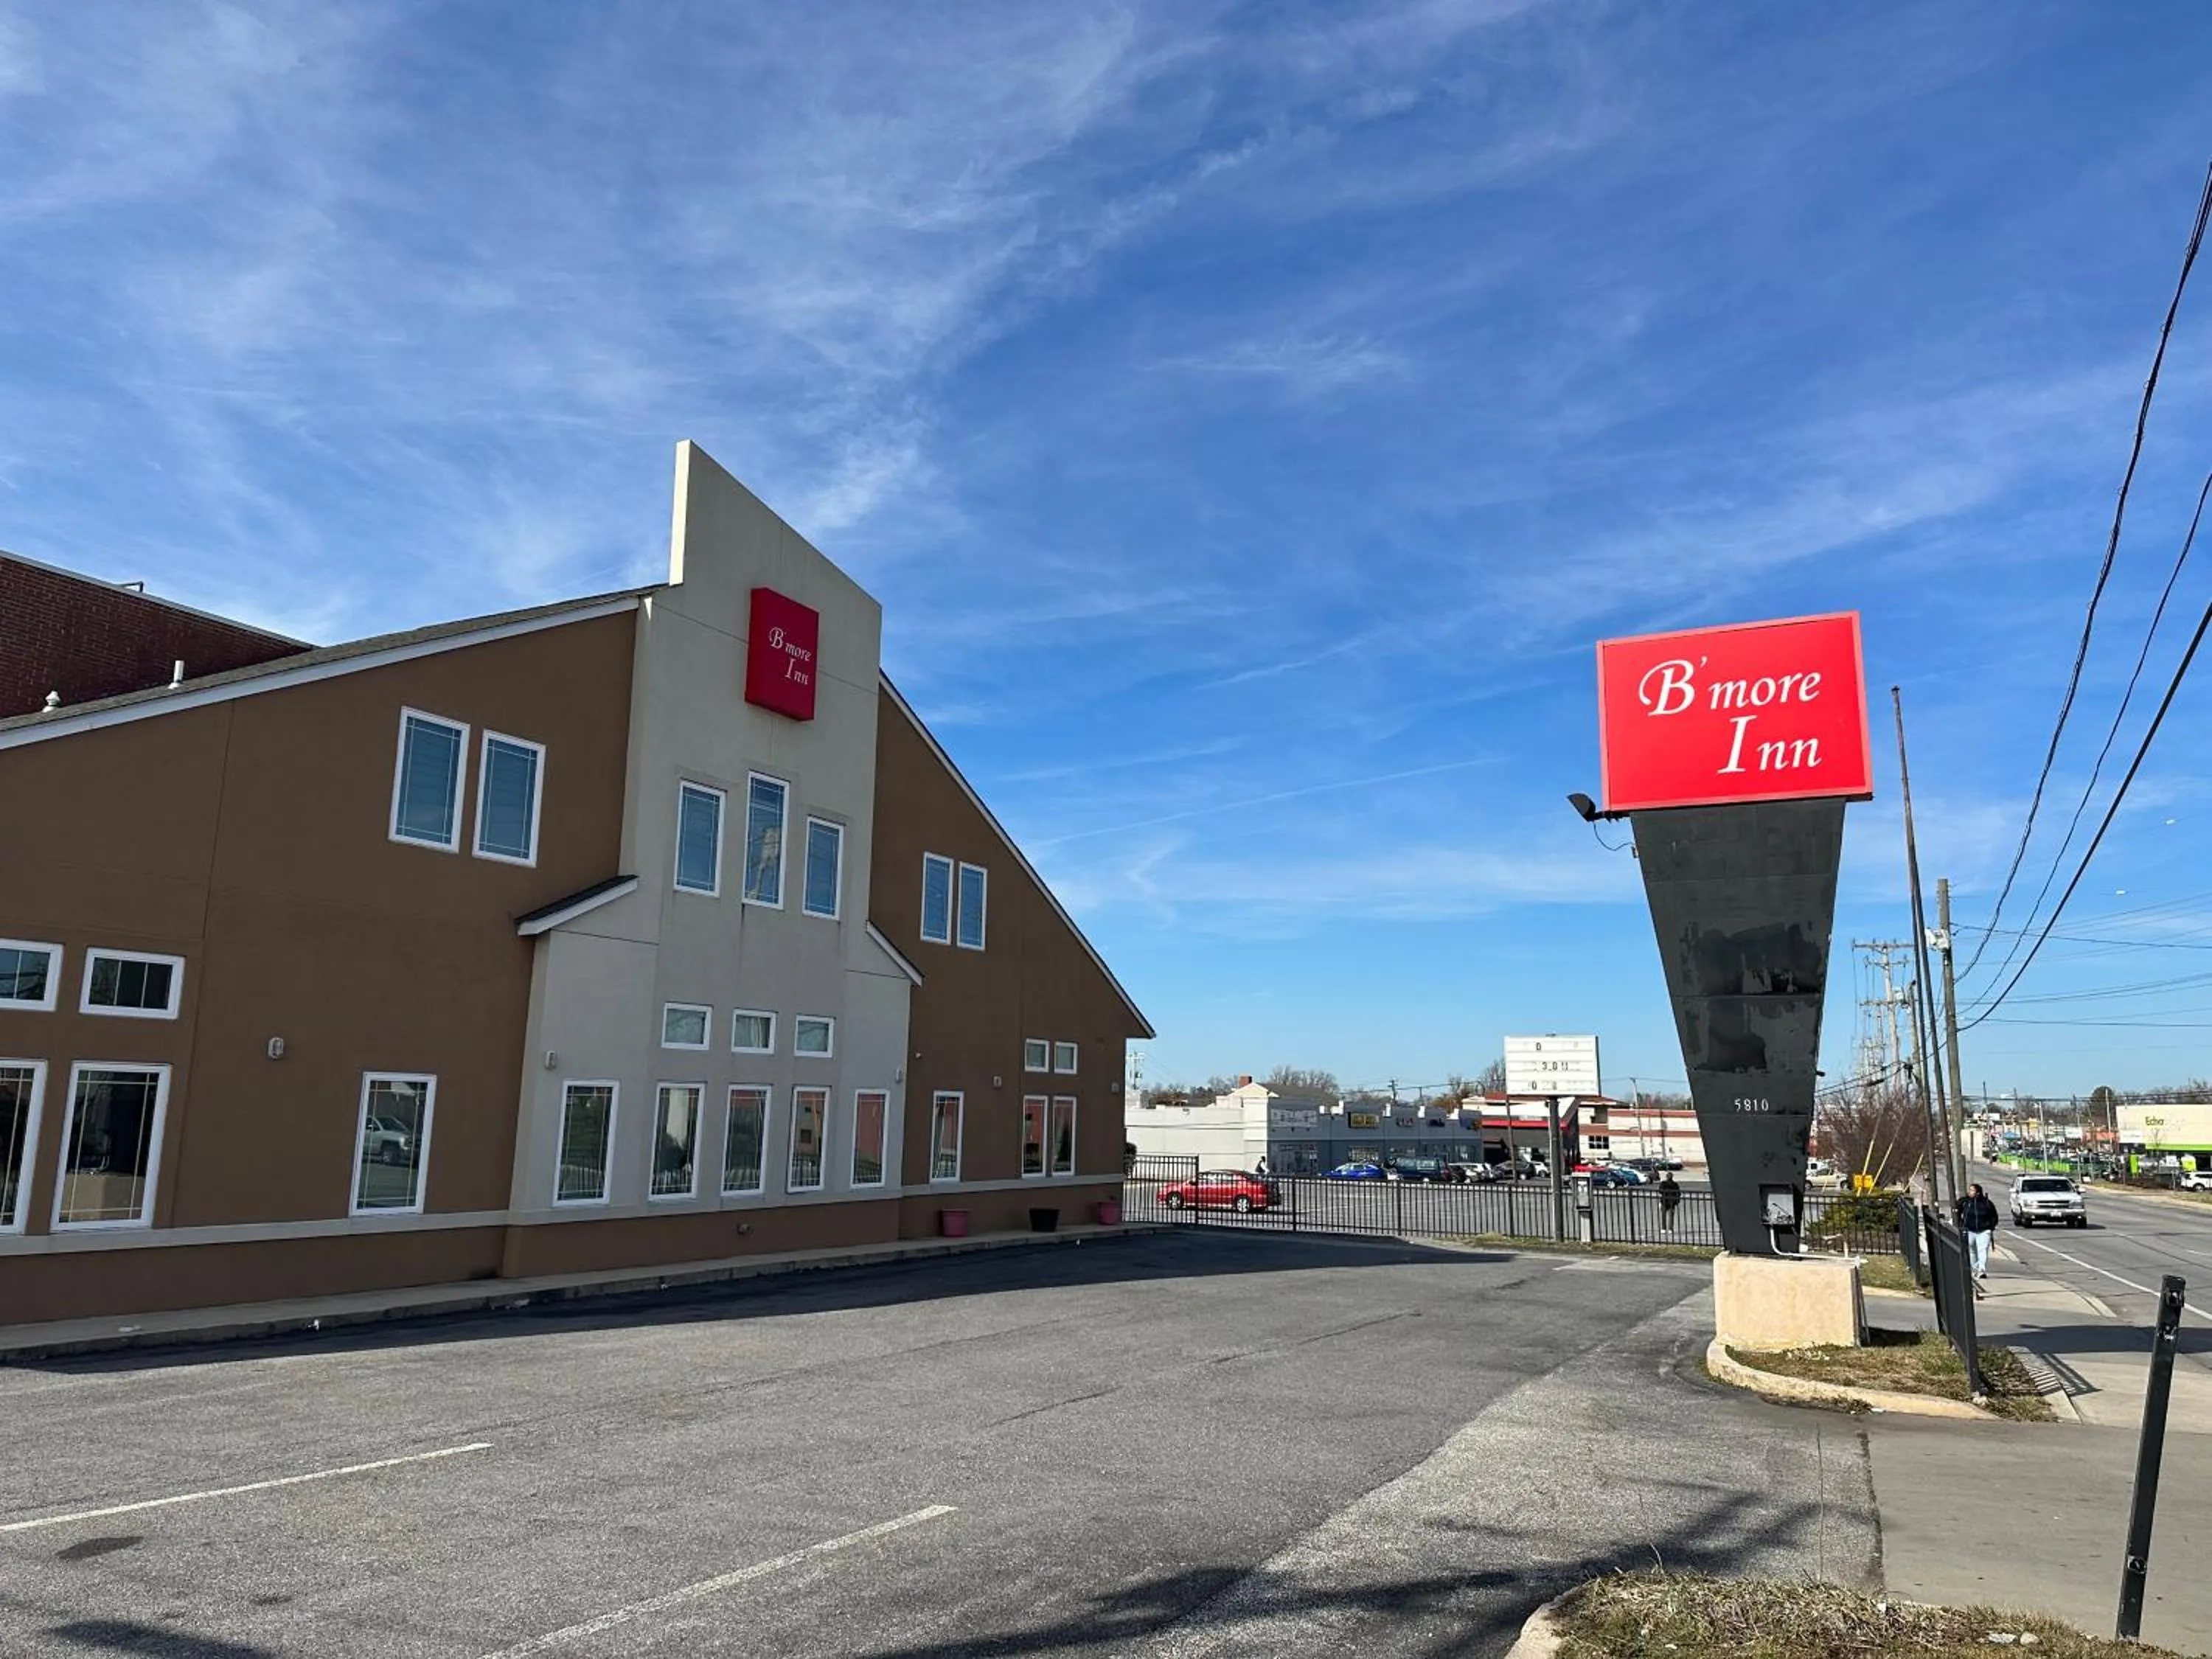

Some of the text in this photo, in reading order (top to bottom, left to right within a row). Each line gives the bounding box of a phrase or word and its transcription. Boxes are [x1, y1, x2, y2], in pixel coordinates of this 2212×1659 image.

[785, 658, 809, 685] Inn
[1638, 655, 1820, 716] B'more
[1717, 714, 1821, 773] Inn
[1734, 1098, 1769, 1112] 5810
